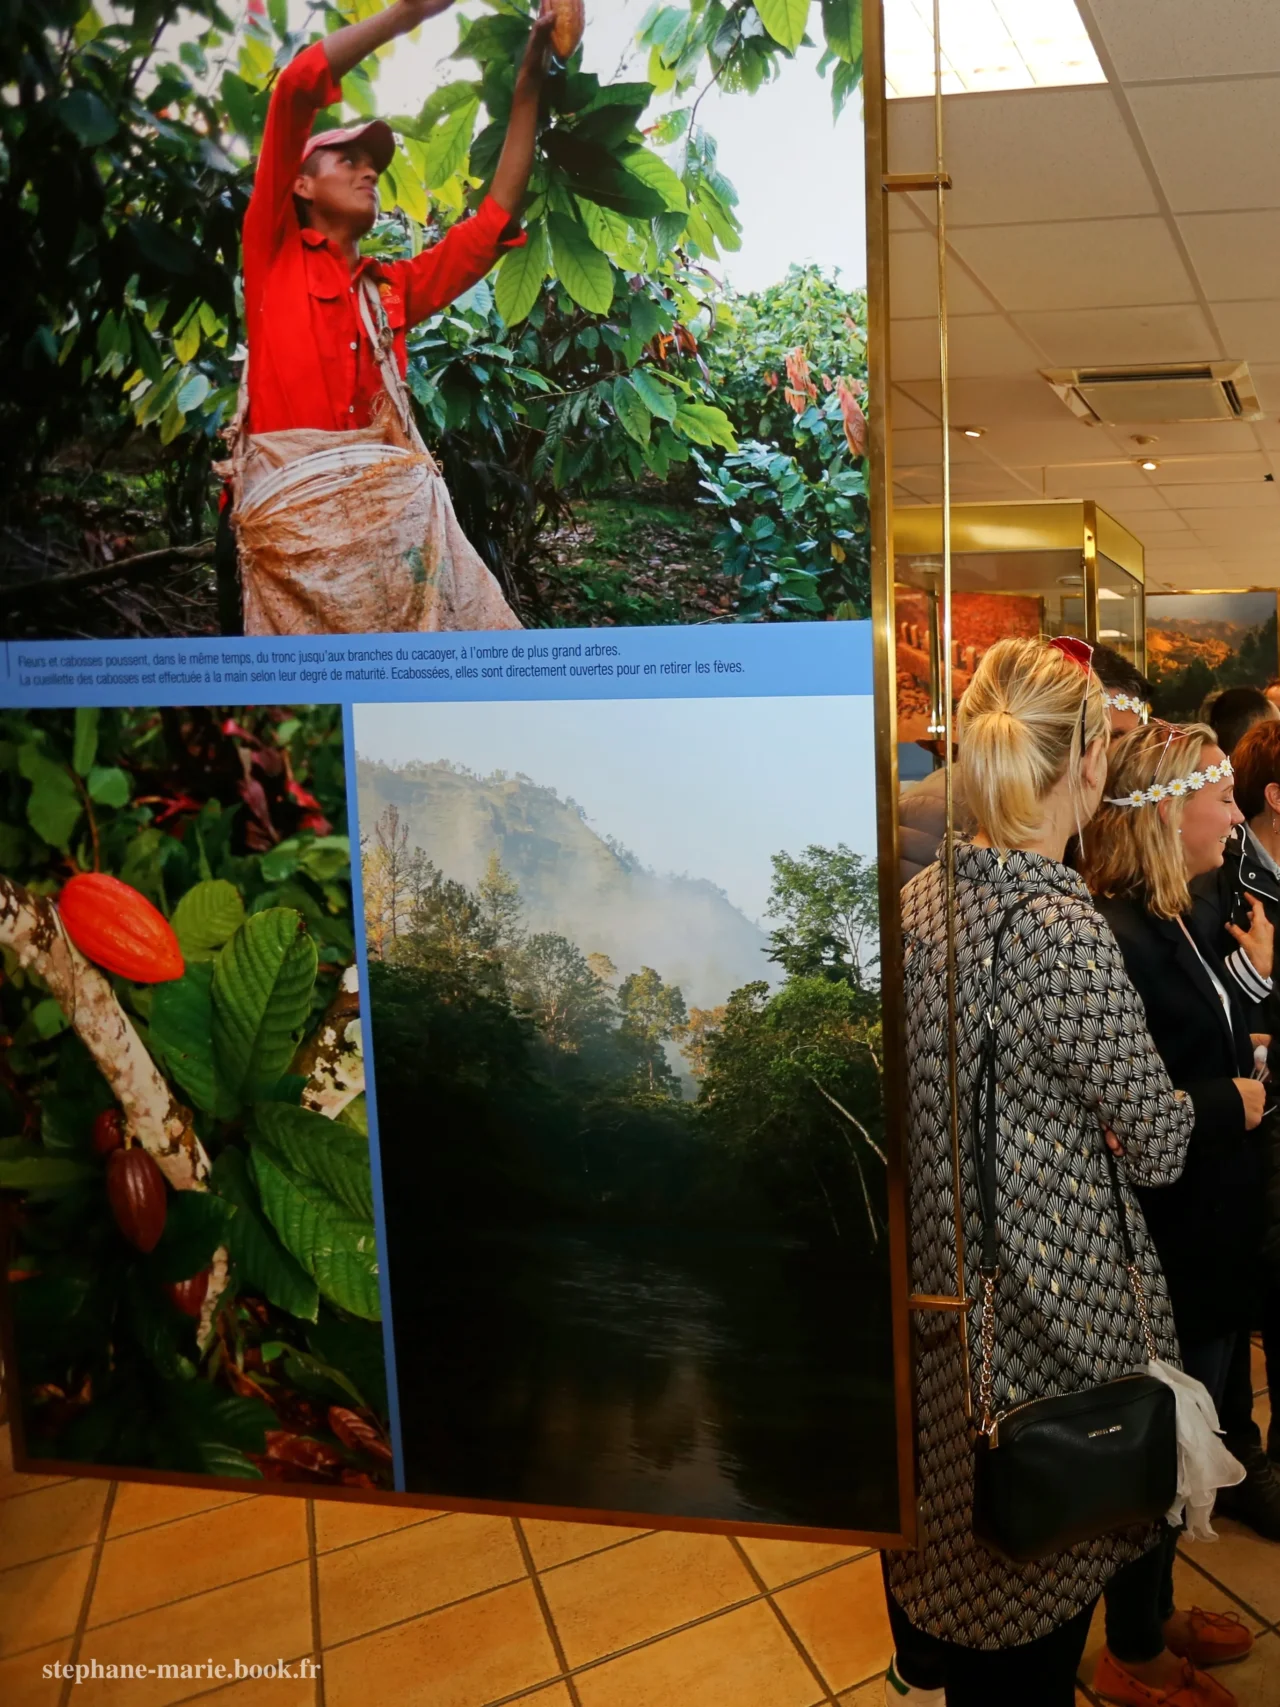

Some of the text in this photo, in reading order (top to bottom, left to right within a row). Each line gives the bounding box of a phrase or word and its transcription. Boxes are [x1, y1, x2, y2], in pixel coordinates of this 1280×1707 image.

[18, 643, 621, 671] Fleurs et cabosses poussent, dans le même temps, du tronc jusqu'aux branches du cacaoyer, à l'ombre de plus grand arbres.
[19, 659, 746, 686] La cueillette des cabosses est effectuée à la main selon leur degré de maturité. Ecabossées, elles sont directement ouvertes pour en retirer les fèves.
